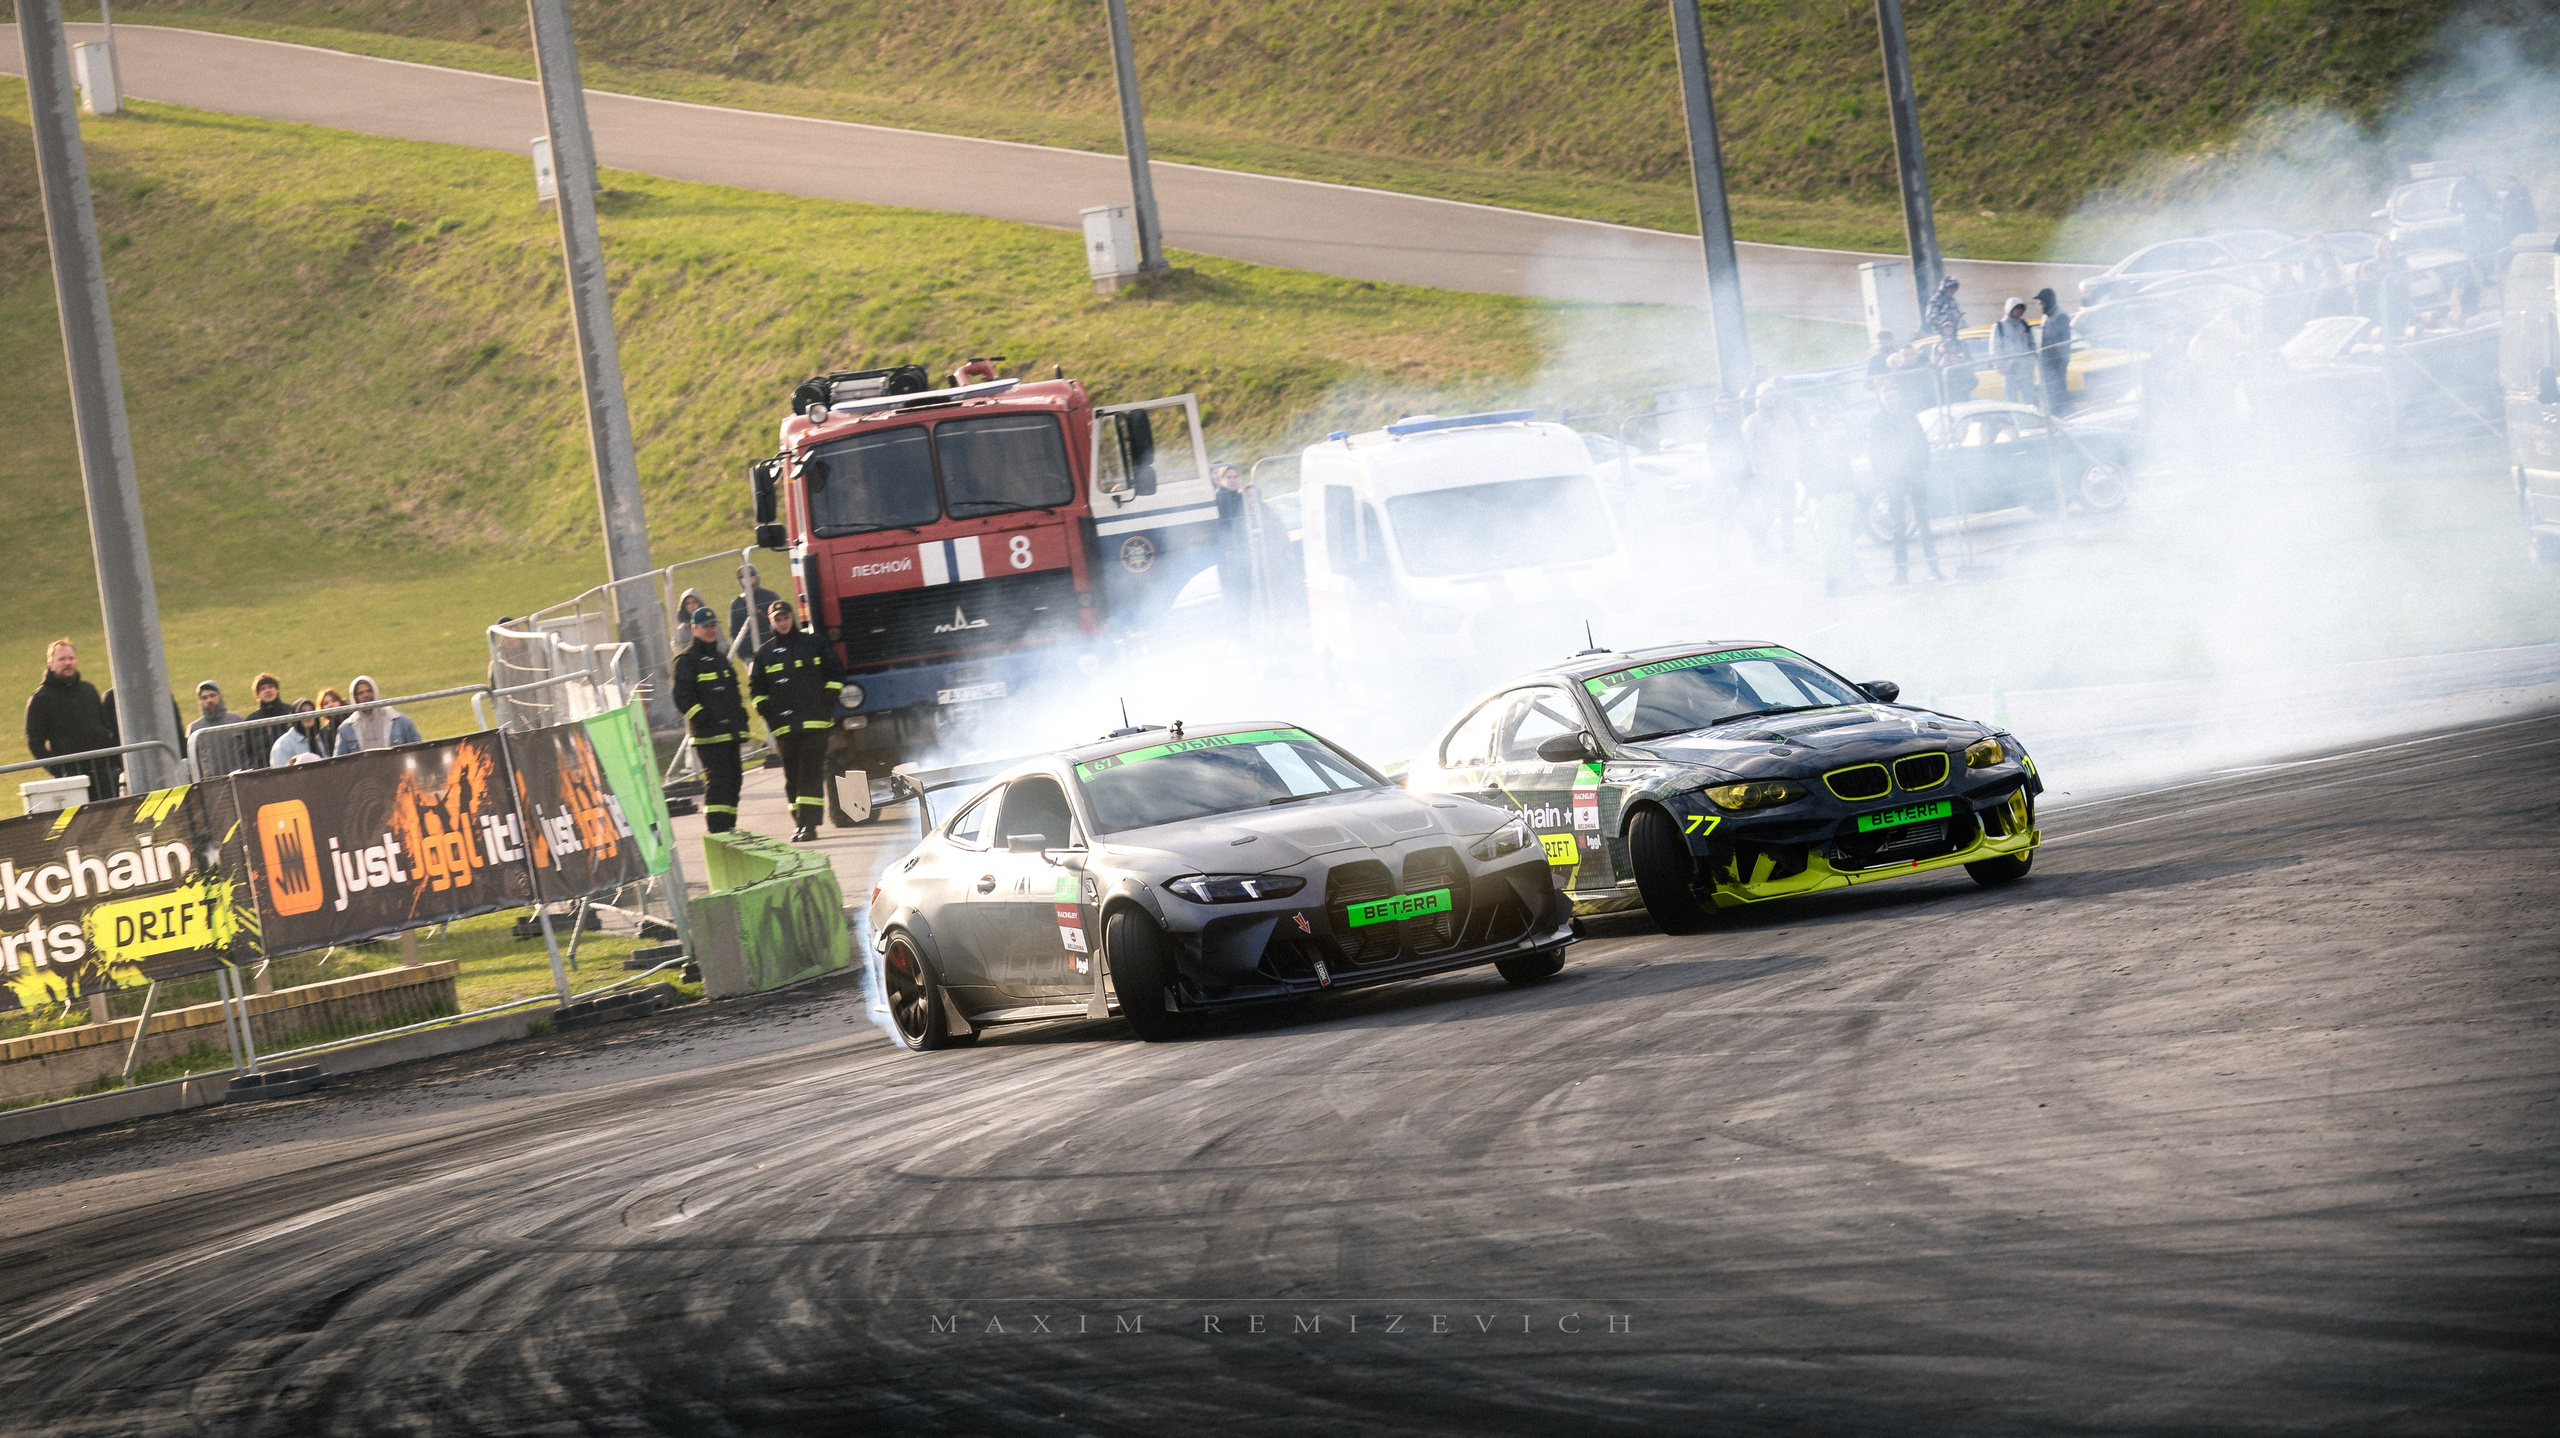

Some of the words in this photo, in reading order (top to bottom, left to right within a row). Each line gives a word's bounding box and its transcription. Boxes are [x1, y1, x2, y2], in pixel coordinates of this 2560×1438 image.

[851, 556, 912, 578] ЛЕСНОЙ
[1008, 534, 1034, 570] 8
[1605, 673, 1627, 686] 77
[1164, 735, 1232, 754] ГУБИН
[1093, 757, 1113, 772] 67
[535, 803, 583, 872] just
[1684, 815, 1722, 837] 77
[0, 835, 192, 912] kchain
[329, 832, 407, 912] just
[479, 812, 526, 867] it!
[115, 897, 218, 949] DRIFT
[0, 917, 87, 974] rts
